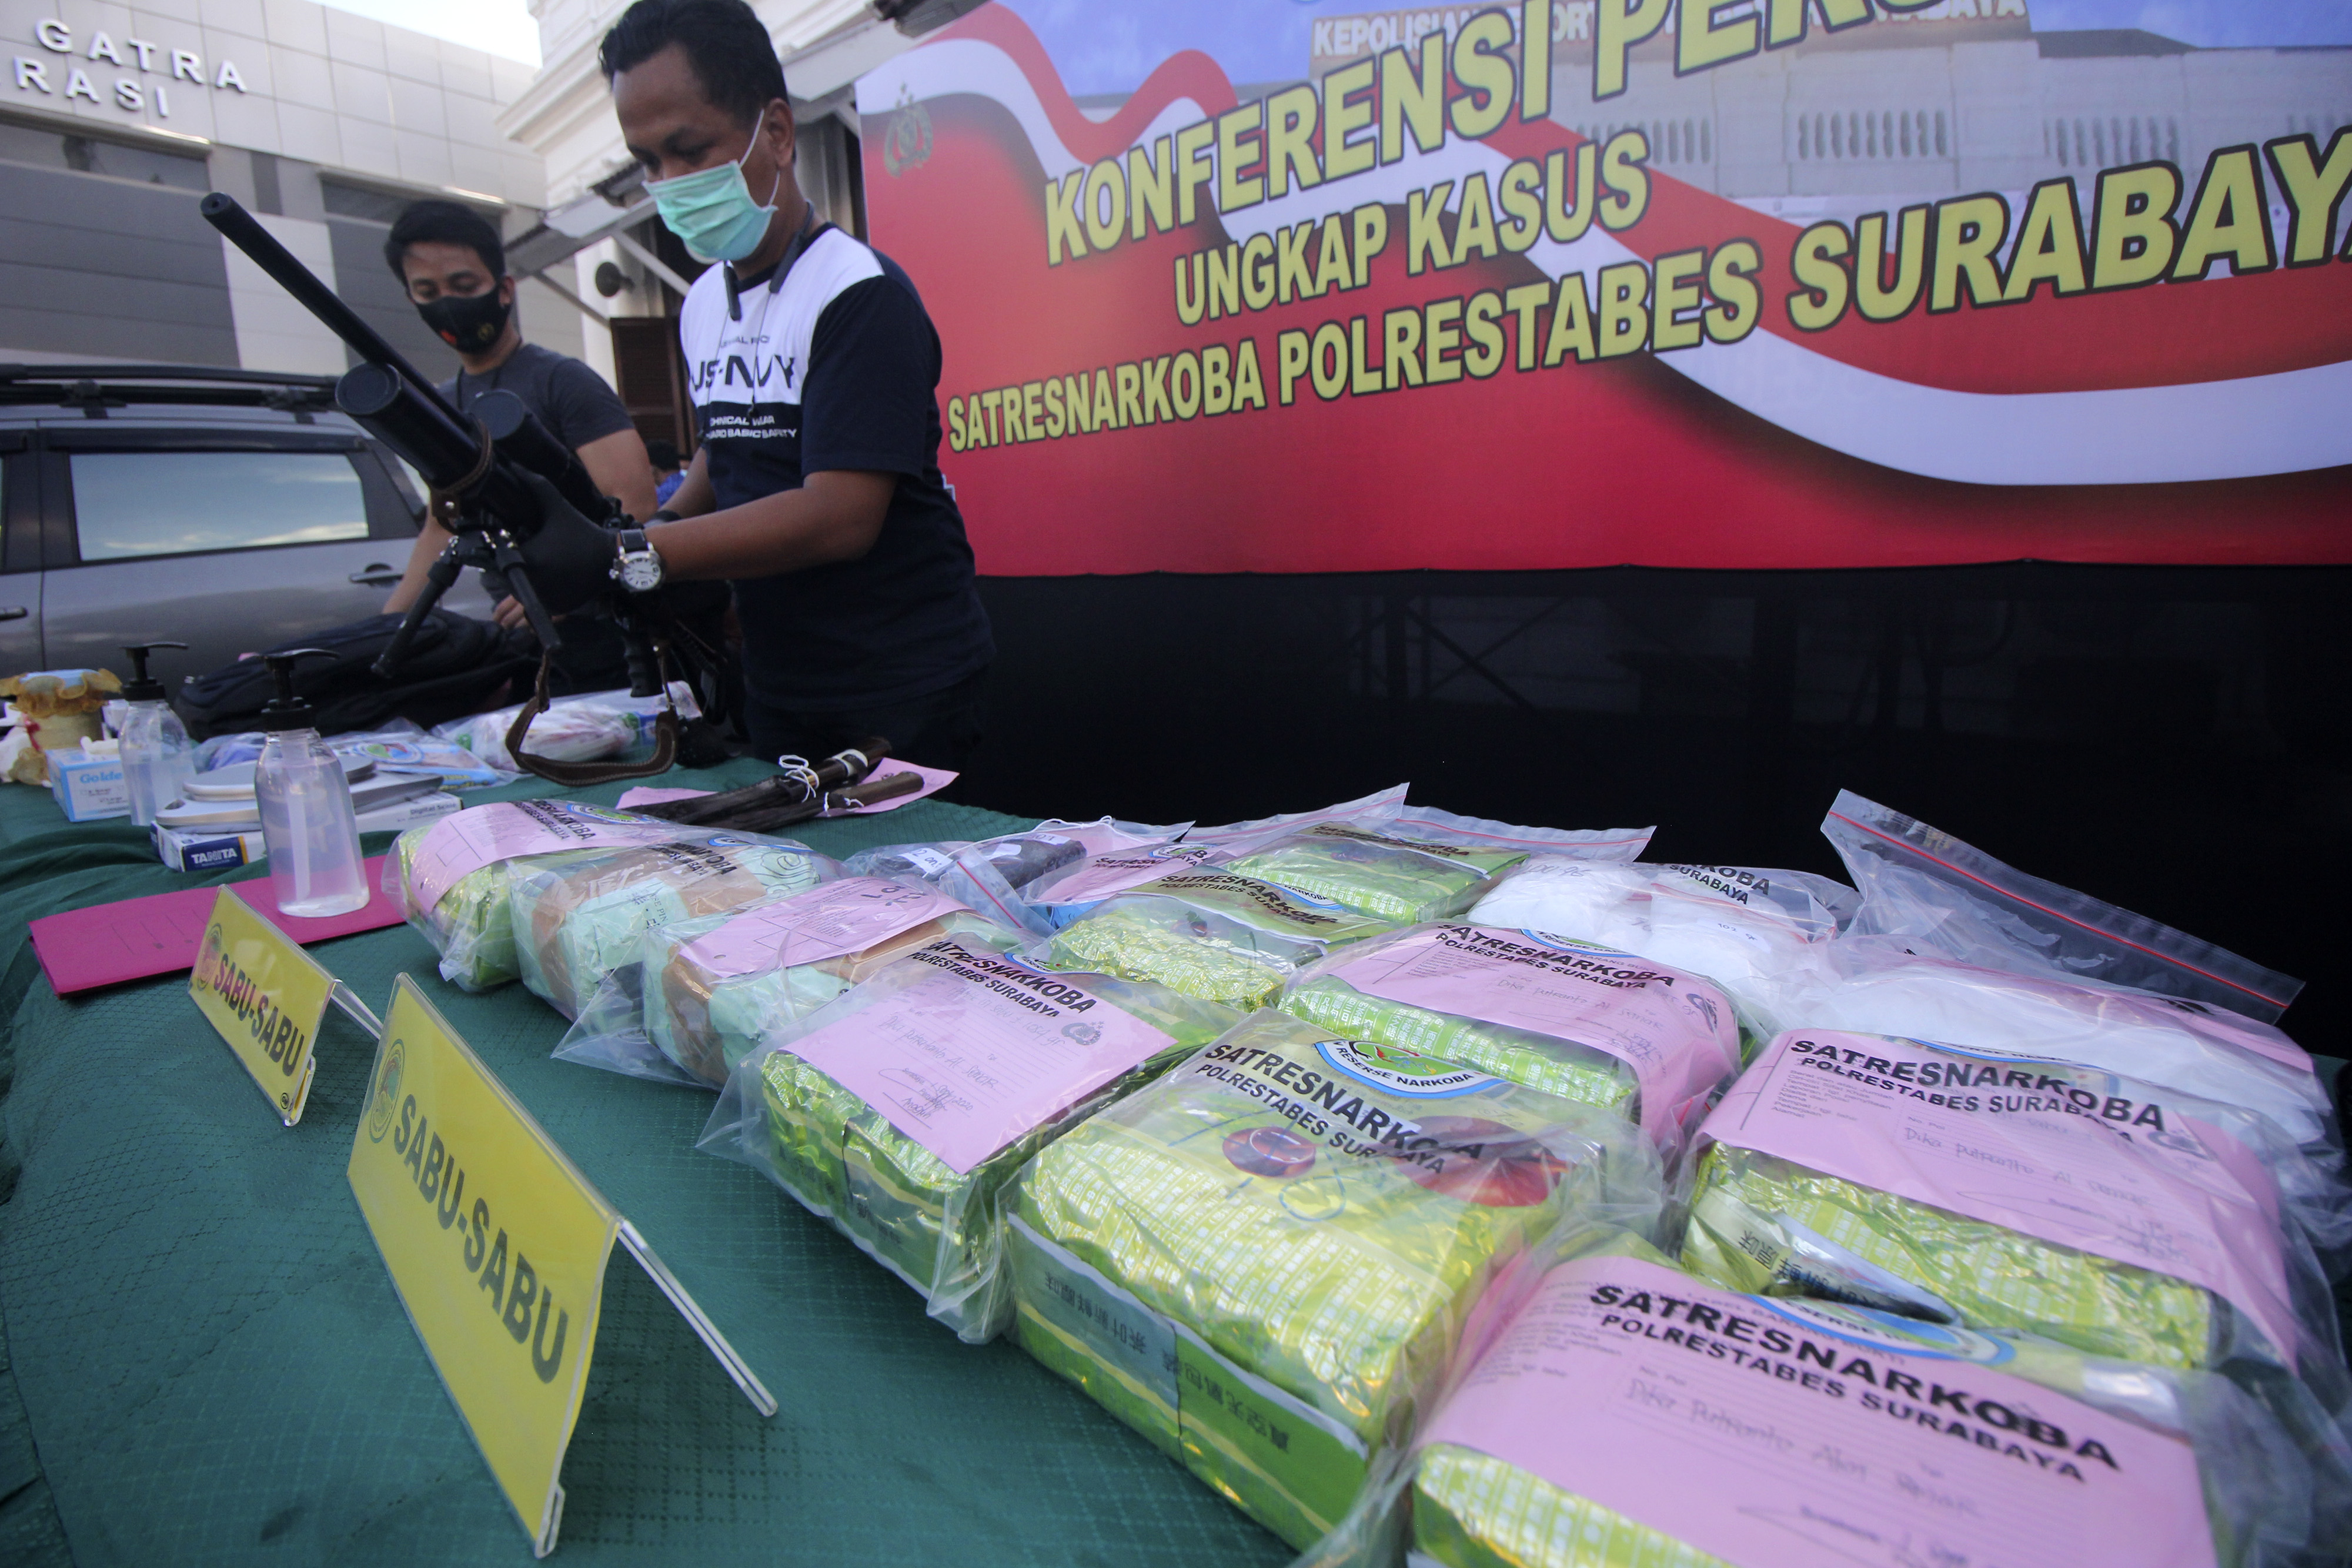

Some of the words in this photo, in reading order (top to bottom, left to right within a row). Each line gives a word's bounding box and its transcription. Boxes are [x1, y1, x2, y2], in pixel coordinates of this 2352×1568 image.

[35, 17, 248, 93] GATRA
[1312, 9, 1479, 58] KEPOLISIA
[1045, 0, 1552, 268] KONFERENSI
[1174, 202, 1388, 326] UNGKAP
[1406, 129, 1652, 276] KASUS
[947, 336, 1267, 453] SATRESNARKOBA
[1277, 236, 1763, 407] POLRESTABES
[1786, 125, 2352, 333] SURABAY
[191, 847, 238, 864] TANITA
[1158, 882, 1245, 893] POLRESTABES
[1670, 865, 1749, 905] SURABAYA
[907, 951, 989, 983] POLRESTABES
[985, 979, 1061, 1018] SURABAYA
[1438, 923, 1676, 987] SATRESNARKOBA
[1551, 966, 1648, 988] SURABAYA
[214, 953, 305, 1077] SABU-SABU
[1205, 1044, 1486, 1159] SATRESNARKOA
[1336, 1047, 1394, 1079] RESERSE
[1396, 1073, 1475, 1087] NARKOBA
[1791, 1040, 2166, 1132] SATRESNARKOBA
[1800, 1057, 1980, 1112] POLRESTABES
[1989, 1095, 2135, 1145] SURABAYA
[1195, 1064, 1329, 1136] POLRESTABES
[1329, 1132, 1446, 1175] SURAYA
[393, 1094, 569, 1385] SABU-SABU
[1590, 1285, 2123, 1472] SATRESNARKOBA
[1601, 1314, 1846, 1398] POLRESTABES
[1860, 1390, 2087, 1485] SURABAYA
